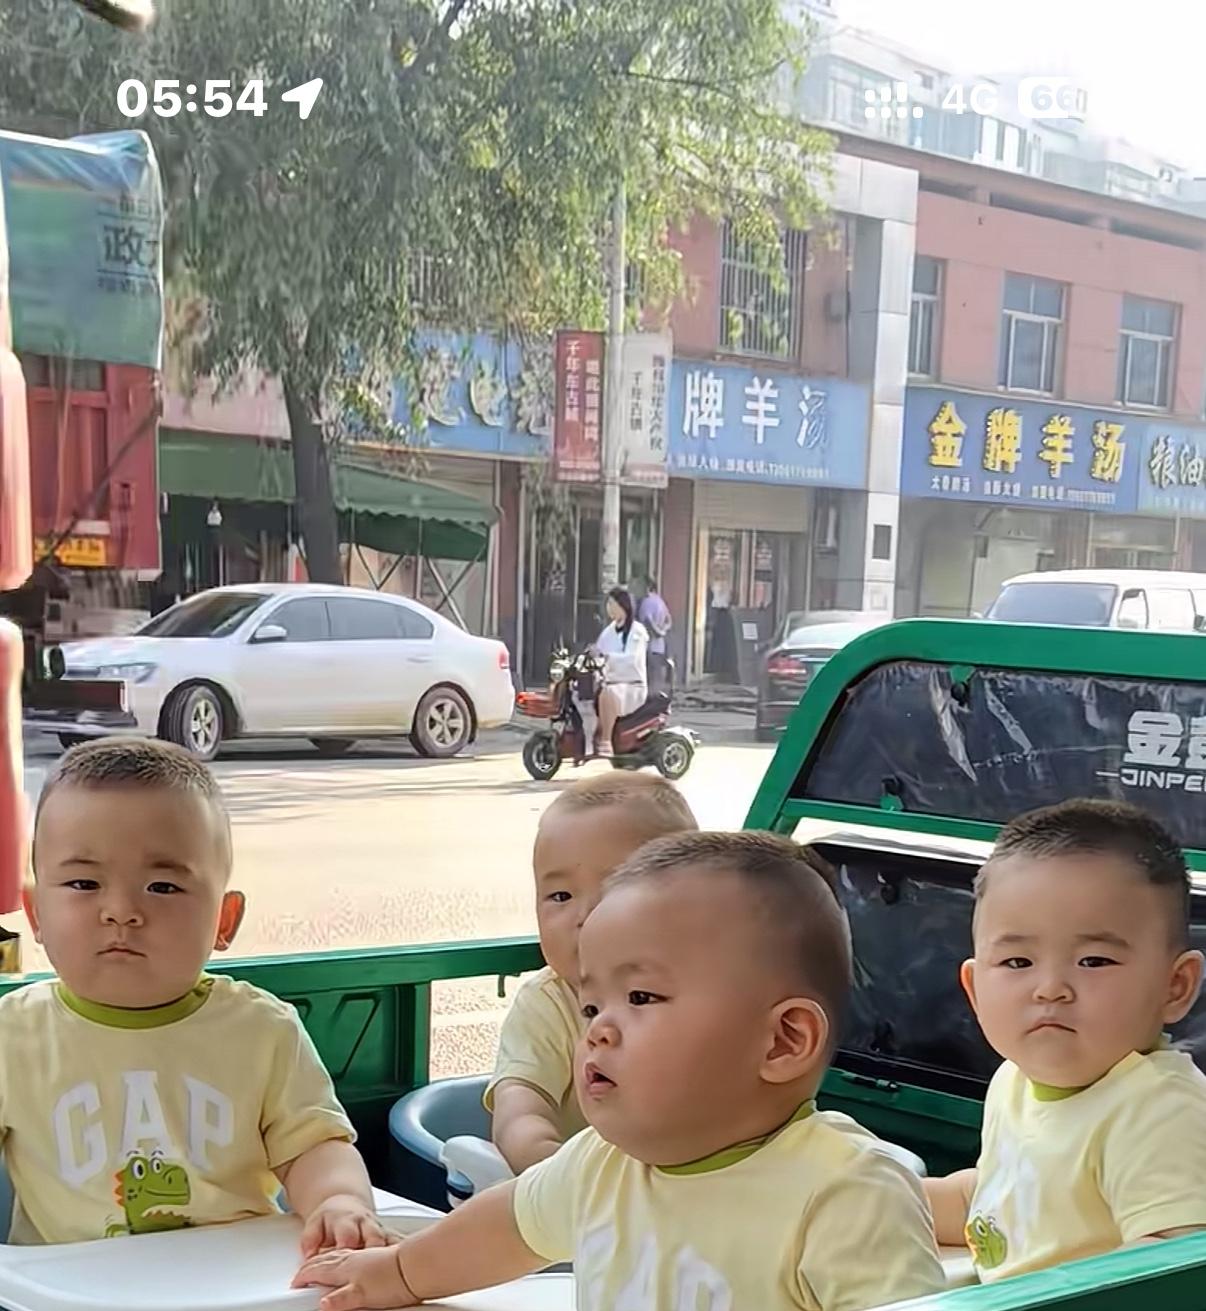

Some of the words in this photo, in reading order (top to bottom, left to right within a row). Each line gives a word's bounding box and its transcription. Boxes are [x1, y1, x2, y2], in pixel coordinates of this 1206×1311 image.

[927, 400, 1126, 483] 金牌羊汤
[1120, 768, 1206, 792] JINPE
[53, 1070, 236, 1190] GAP
